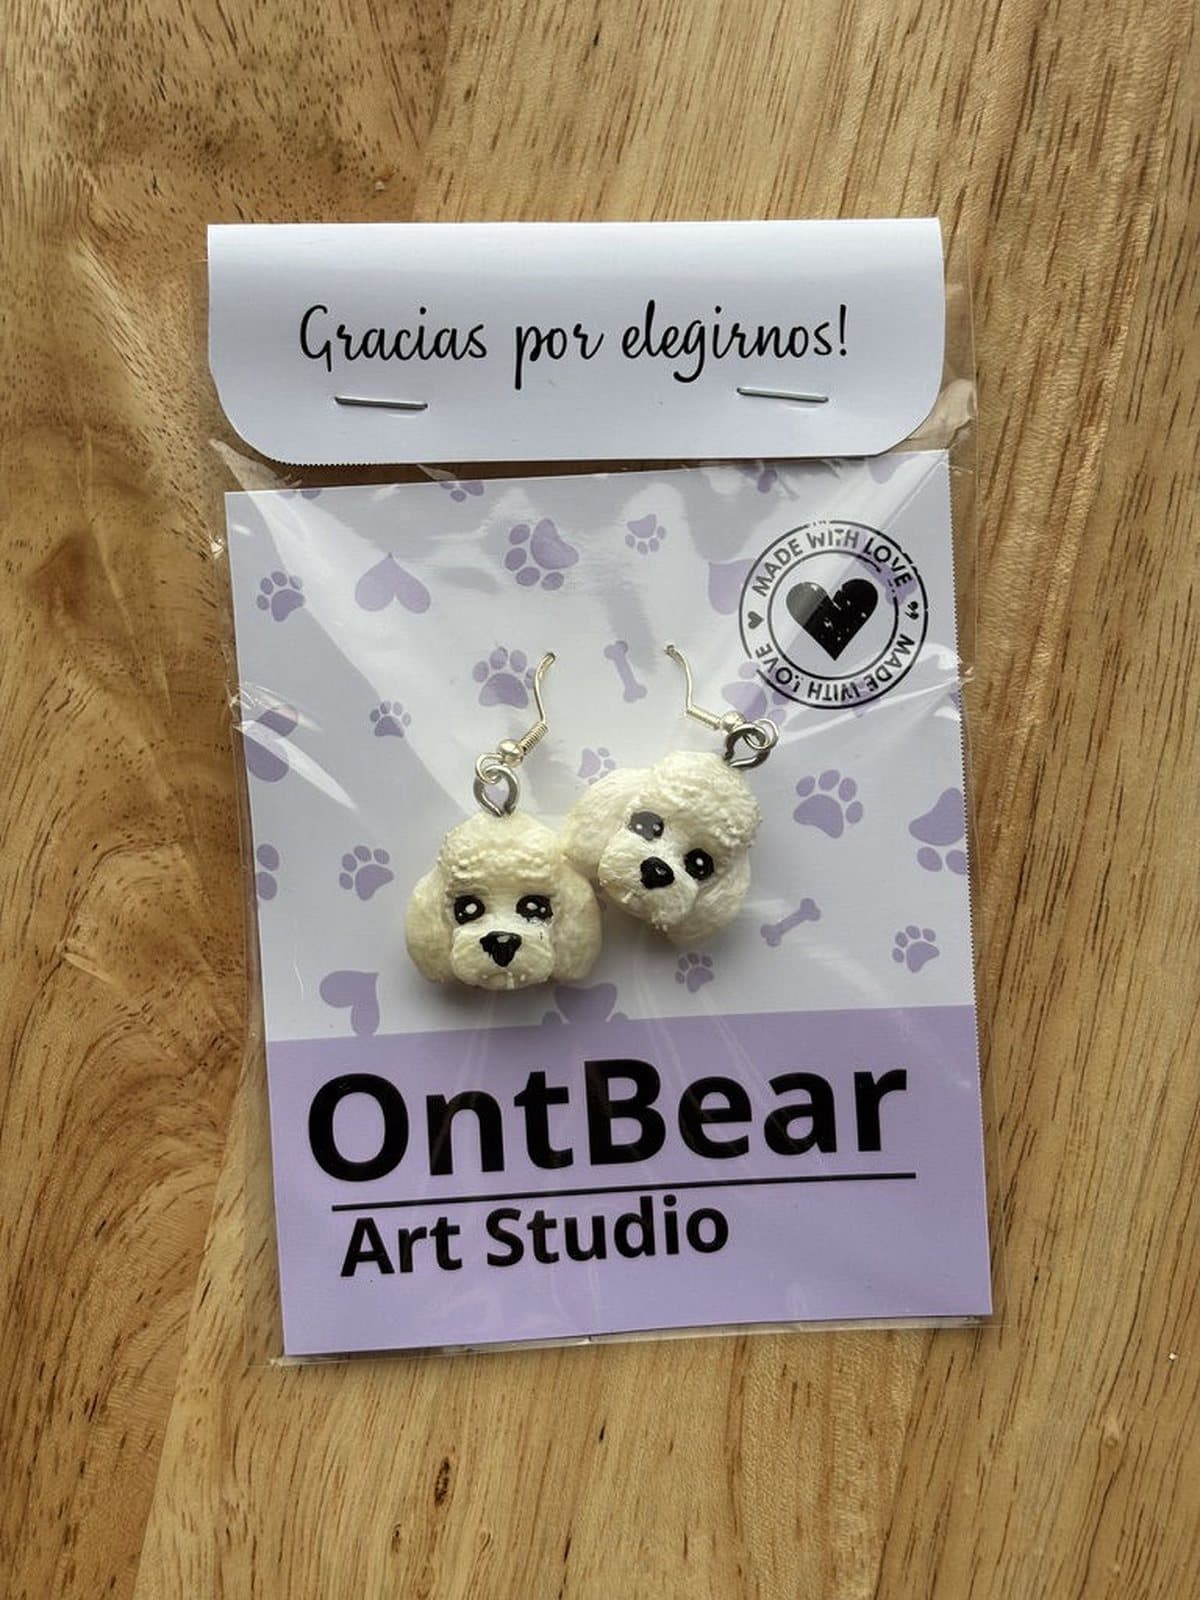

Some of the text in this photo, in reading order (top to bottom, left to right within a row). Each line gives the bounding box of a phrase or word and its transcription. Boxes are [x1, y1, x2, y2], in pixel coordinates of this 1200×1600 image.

[301, 300, 848, 390] Gracias por elegirnos!
[752, 528, 912, 597] MADE WITH LOVE
[807, 681, 861, 702] WITH
[864, 634, 915, 691] MADE
[307, 1058, 907, 1182] OntBear
[340, 1194, 729, 1278] Art Studio
